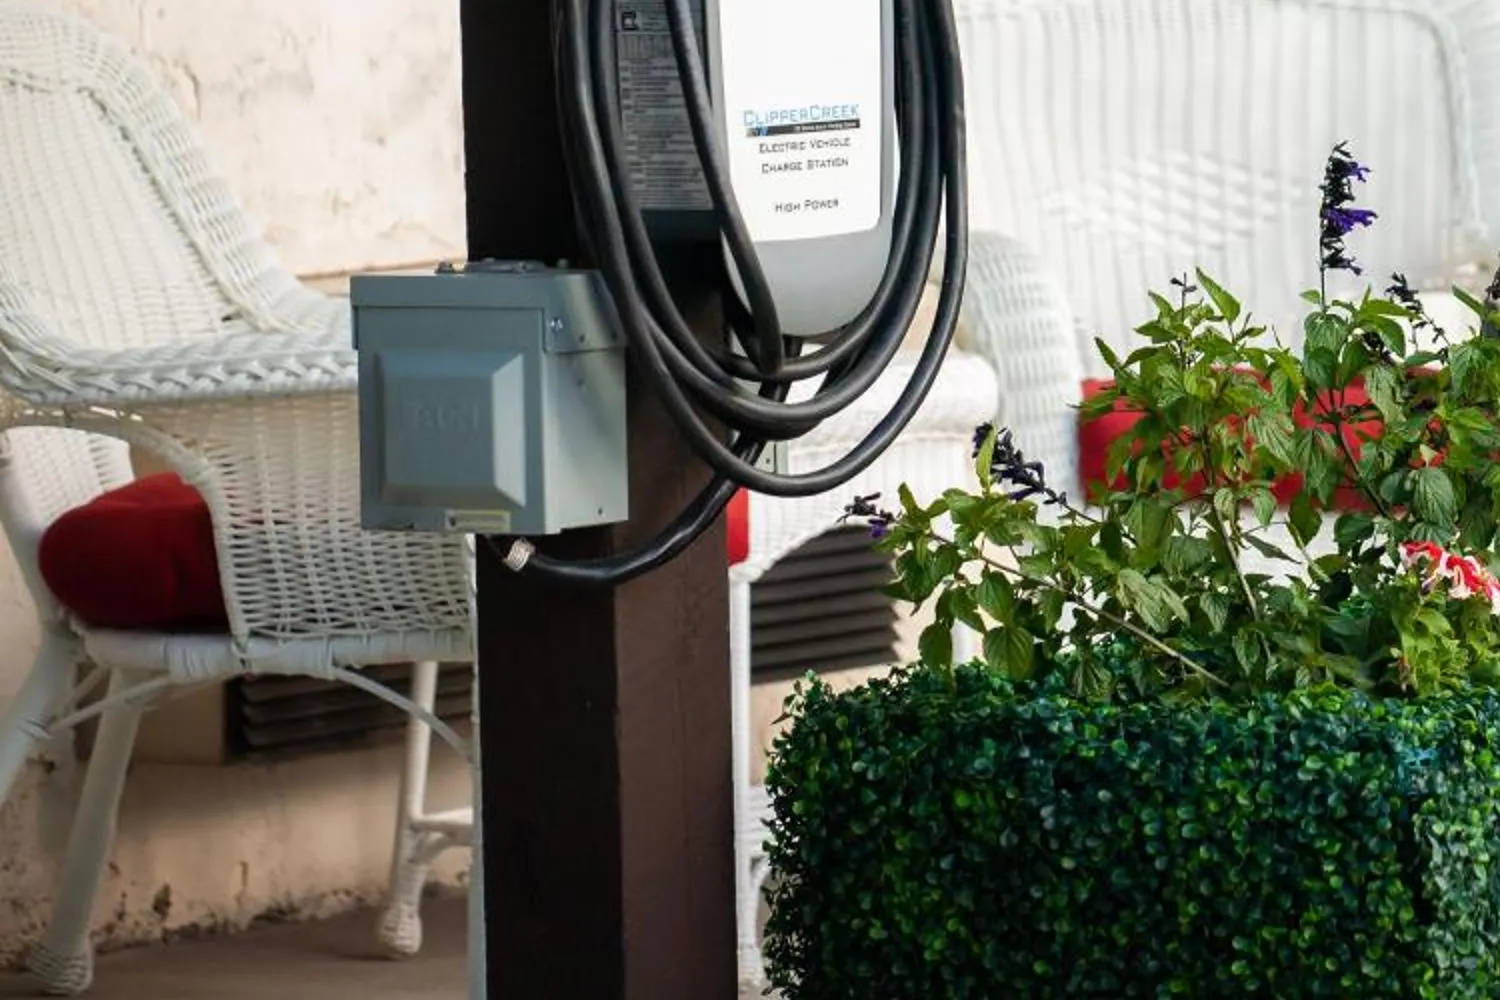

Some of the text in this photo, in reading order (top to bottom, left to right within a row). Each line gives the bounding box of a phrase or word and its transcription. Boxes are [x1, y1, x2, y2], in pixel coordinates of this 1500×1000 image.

[759, 137, 851, 154] ELECTRIC VEHICLE
[761, 157, 849, 174] CHARGE STATION
[775, 198, 839, 213] HIGH POWER
